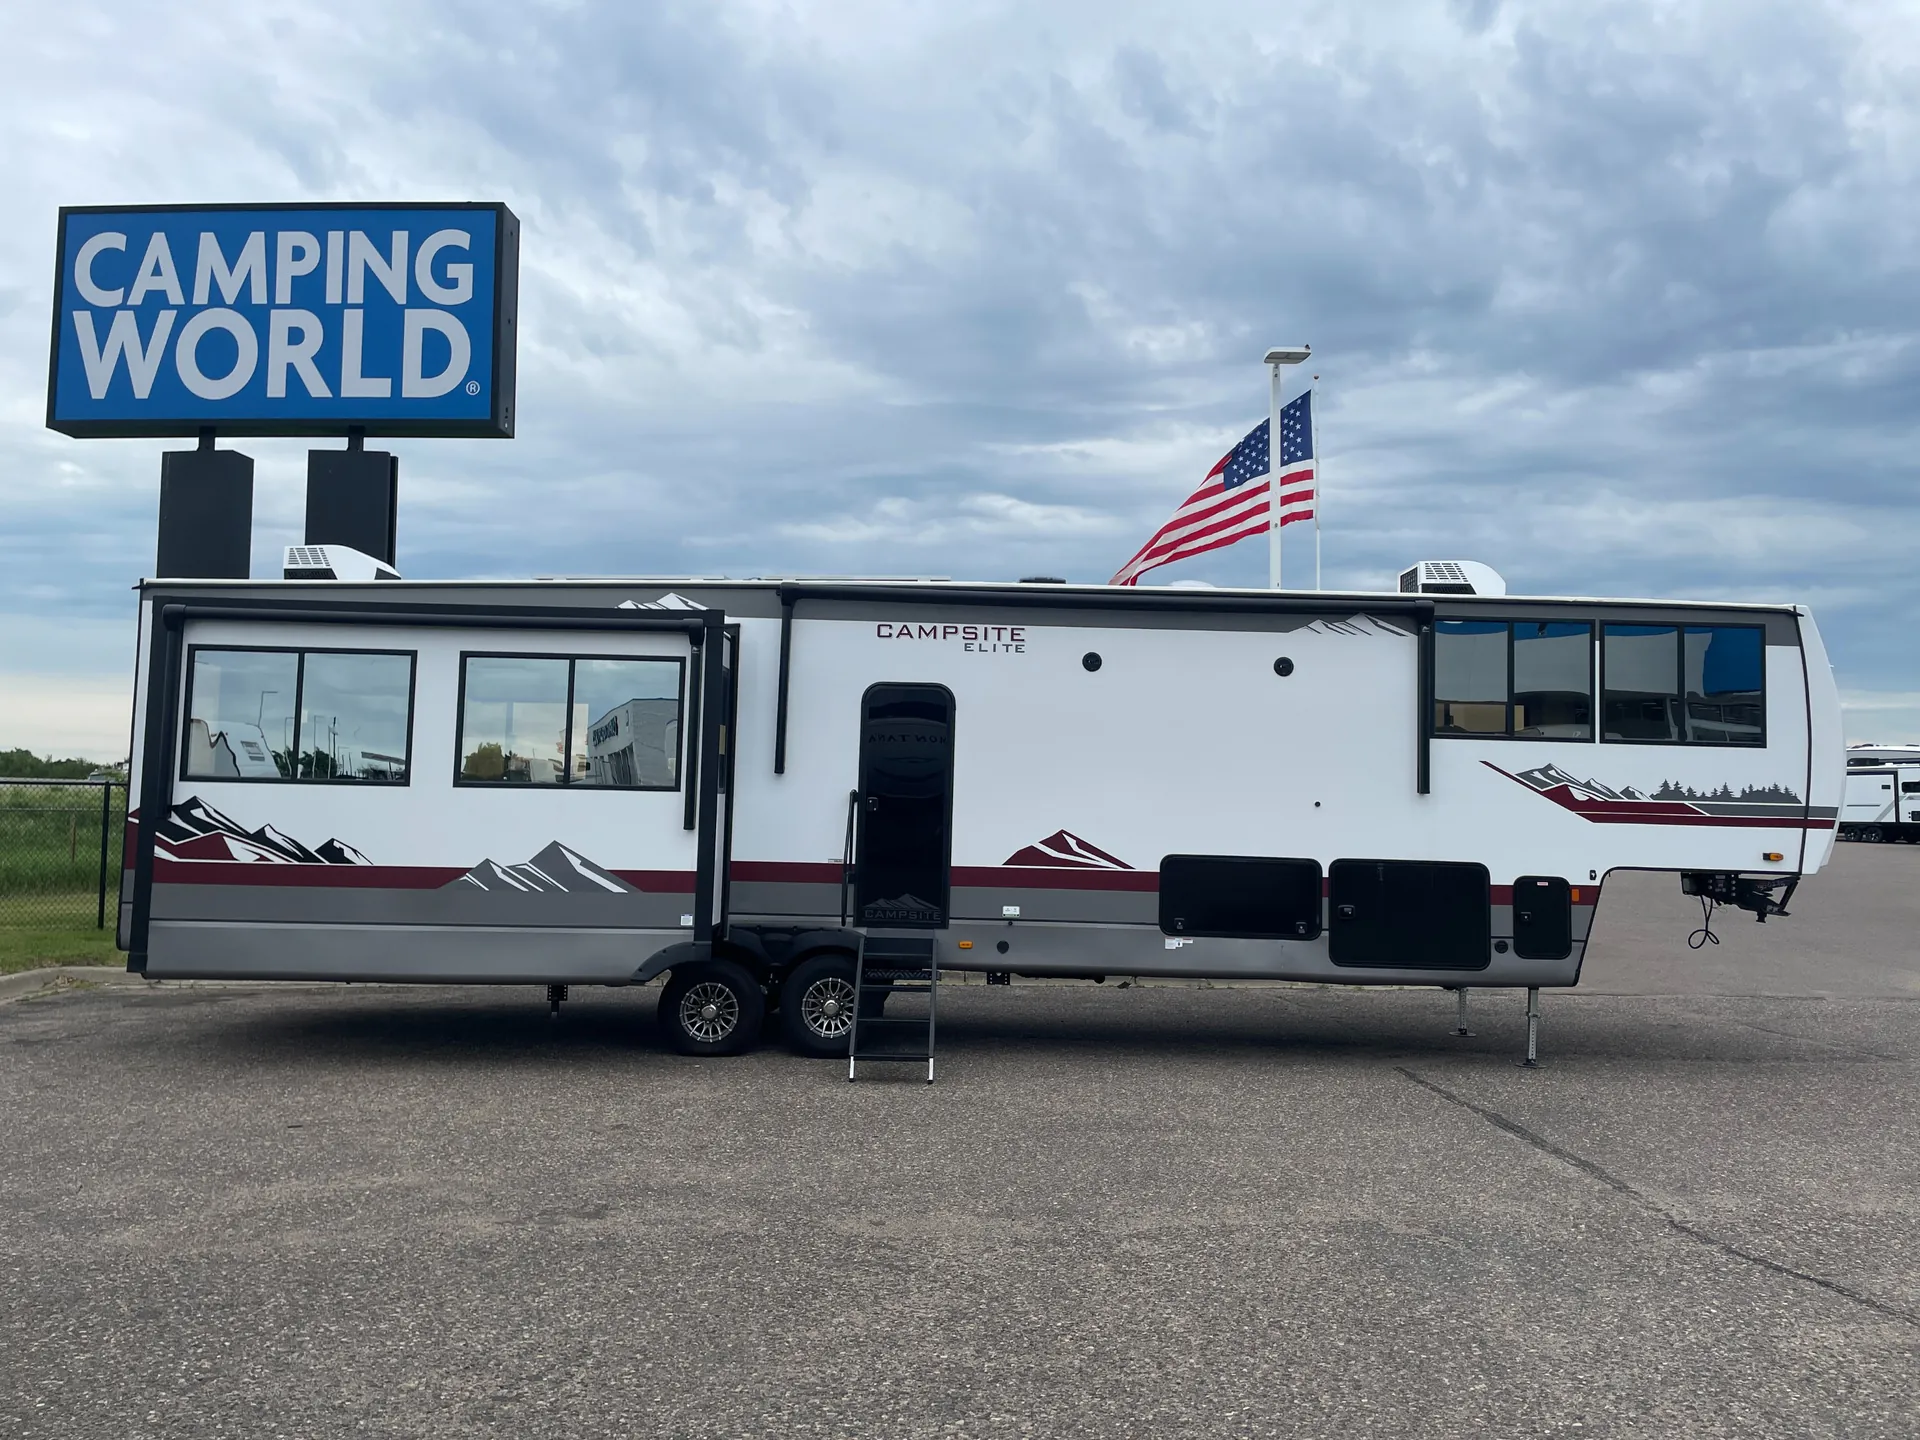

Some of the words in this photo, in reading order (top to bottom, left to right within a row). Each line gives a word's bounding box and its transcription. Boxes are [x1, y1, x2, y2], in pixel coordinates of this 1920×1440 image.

[74, 229, 474, 308] CAMPING
[876, 623, 1026, 642] CAMPSITE
[963, 642, 1026, 654] ELITE
[864, 909, 941, 921] CAMPSITE
